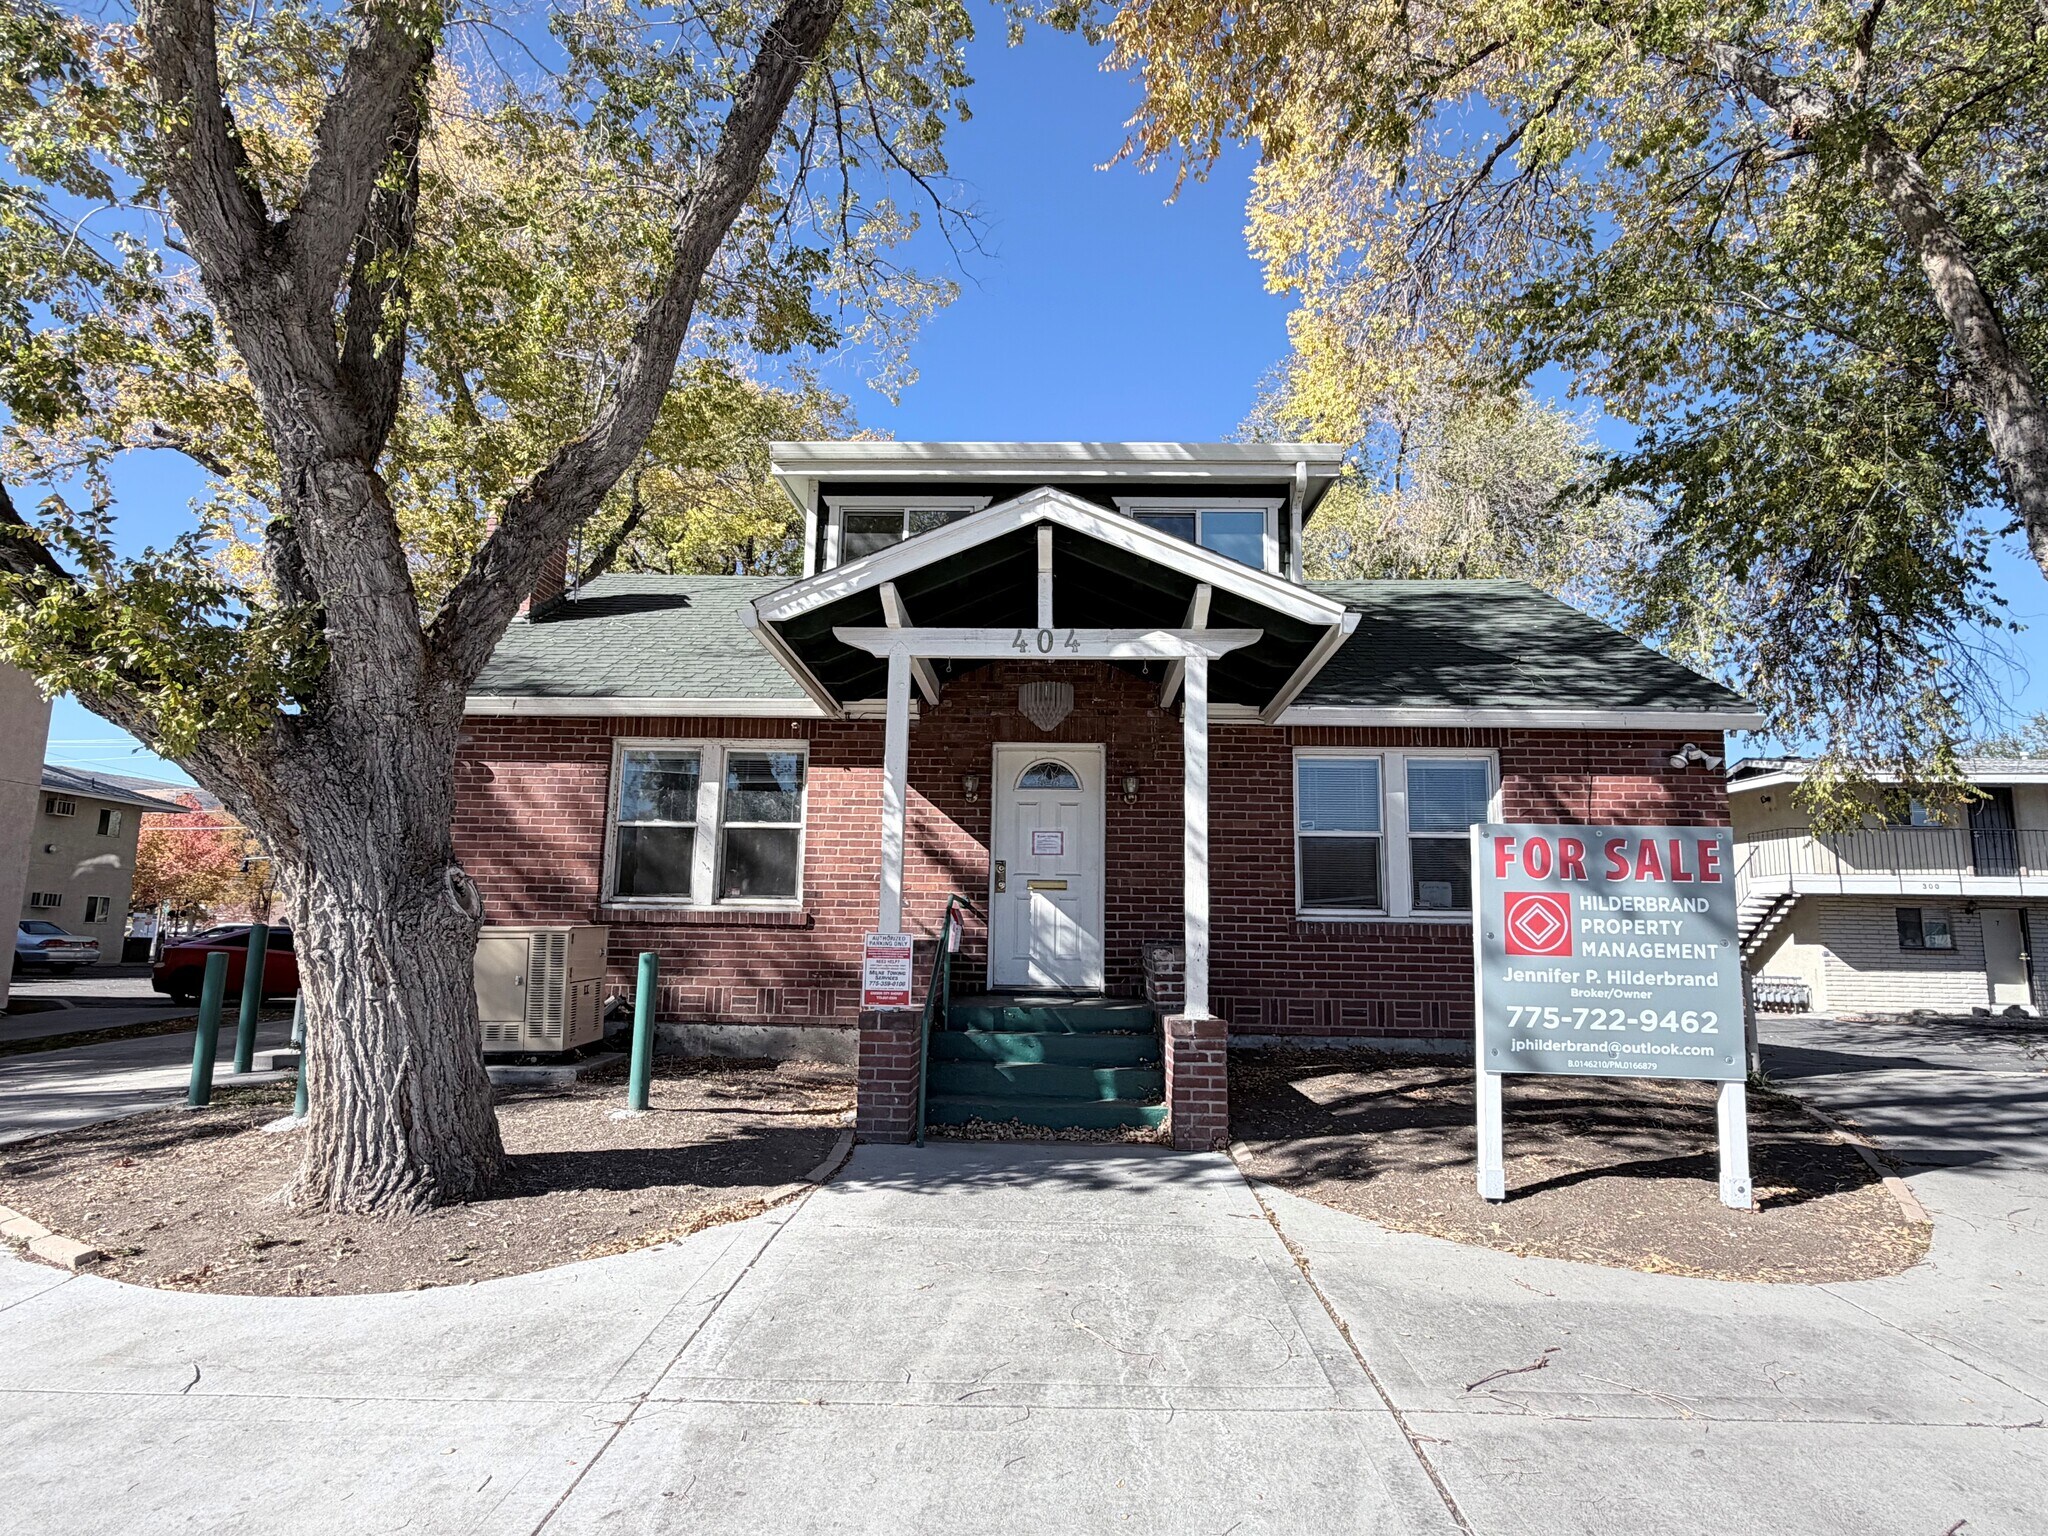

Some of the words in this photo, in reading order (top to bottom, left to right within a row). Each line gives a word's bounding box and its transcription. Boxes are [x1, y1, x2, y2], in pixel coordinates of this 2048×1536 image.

[1012, 629, 1081, 653] 404
[1494, 836, 1588, 881] FOR
[1604, 838, 1723, 884] SALE
[1579, 896, 1710, 913] HILDERBRAND
[1581, 919, 1684, 936] PROPERTY
[1582, 942, 1719, 960] MANAGEMENT
[1502, 967, 1580, 984] Jennifer
[1585, 969, 1601, 985] P.
[1607, 969, 1719, 987] Hilderbrand
[1570, 988, 1653, 1000] Broker/Owner
[1506, 1005, 1719, 1034] 775-722-9462
[1511, 1038, 1715, 1059] jphilderbrand@outlook.com
[1567, 1059, 1658, 1071] B.0146210/PM.0166879
